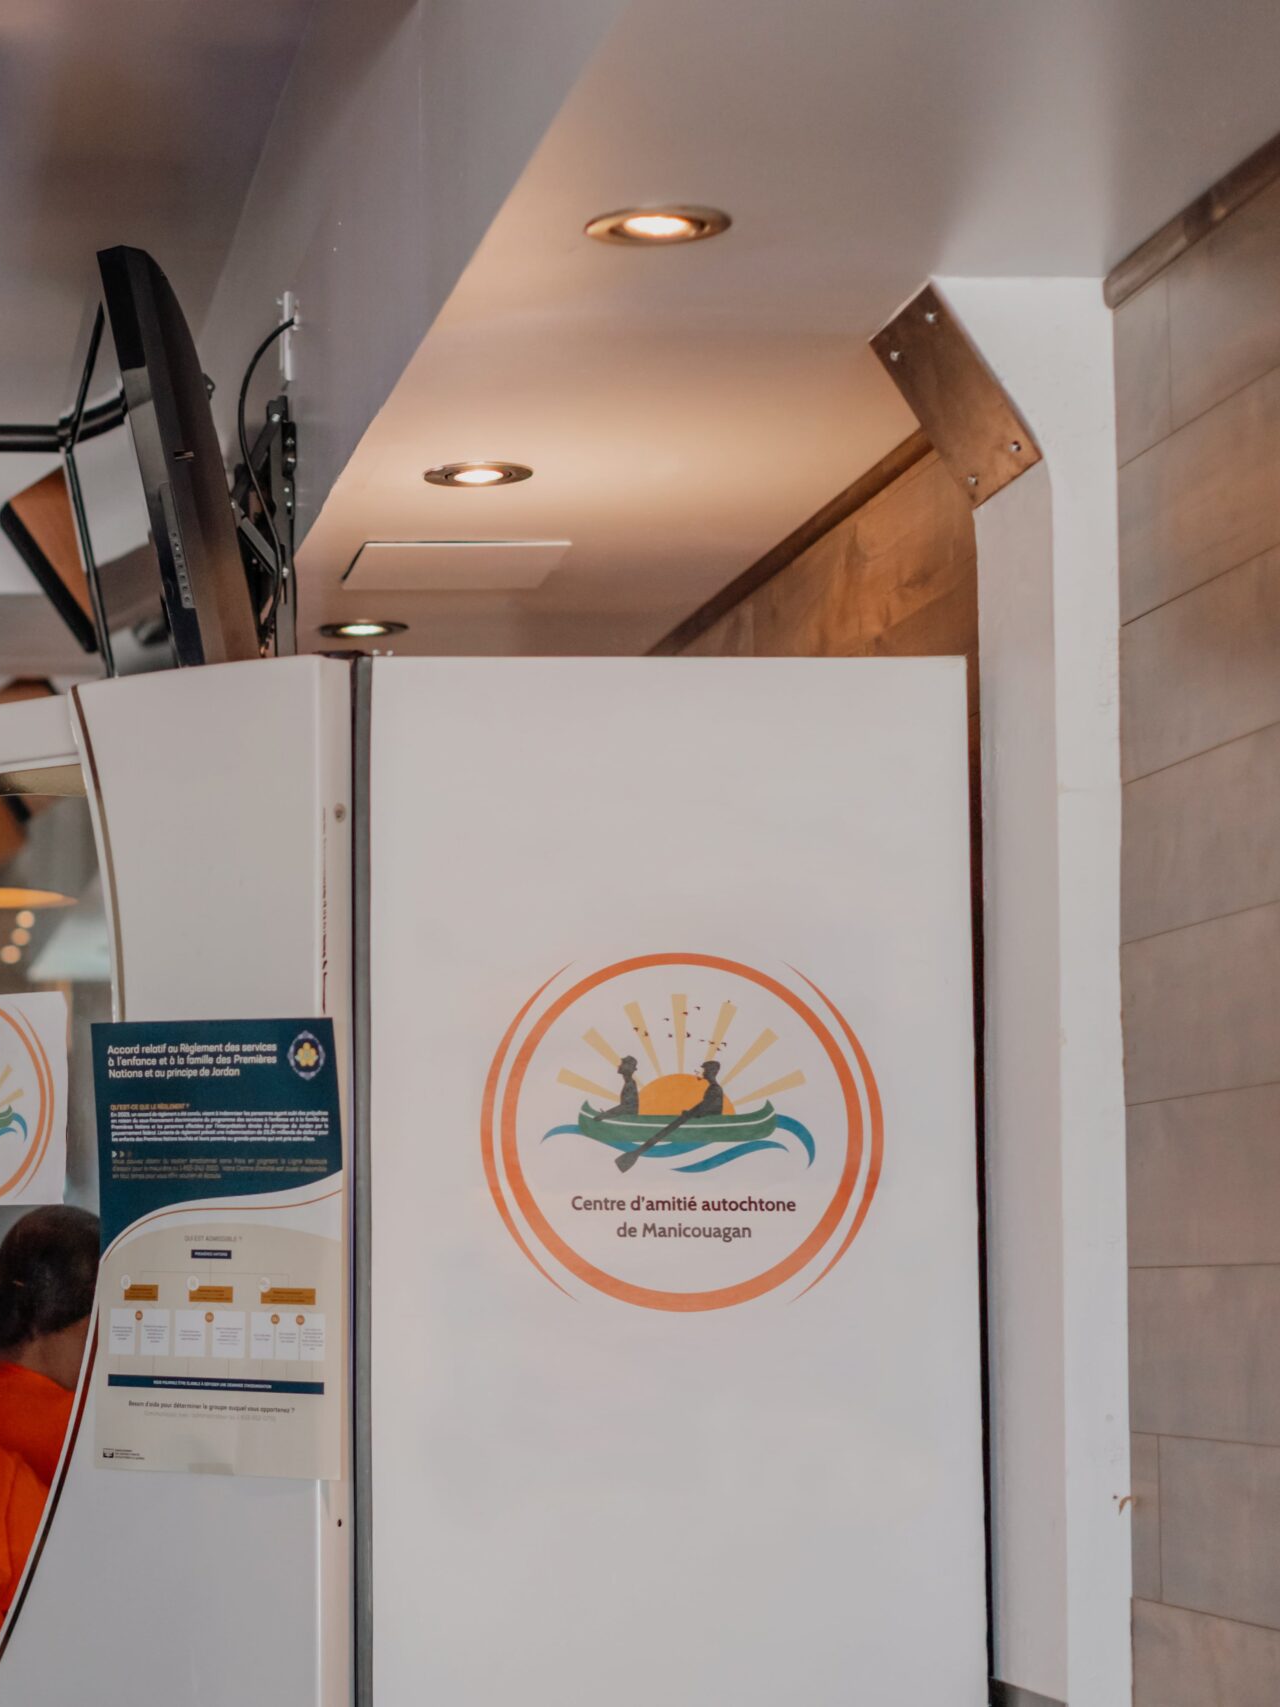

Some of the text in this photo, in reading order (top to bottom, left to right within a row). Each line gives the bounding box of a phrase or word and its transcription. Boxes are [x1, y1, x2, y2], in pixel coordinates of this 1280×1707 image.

[107, 1042, 277, 1055] Accord relatif au Règlement des services
[108, 1054, 277, 1066] à l'enfance et à la famille des Premières
[108, 1066, 240, 1079] Nations et au principe de Jordan
[571, 1194, 797, 1212] Centre d'amitié autochtone
[616, 1222, 752, 1243] de Manicouagan
